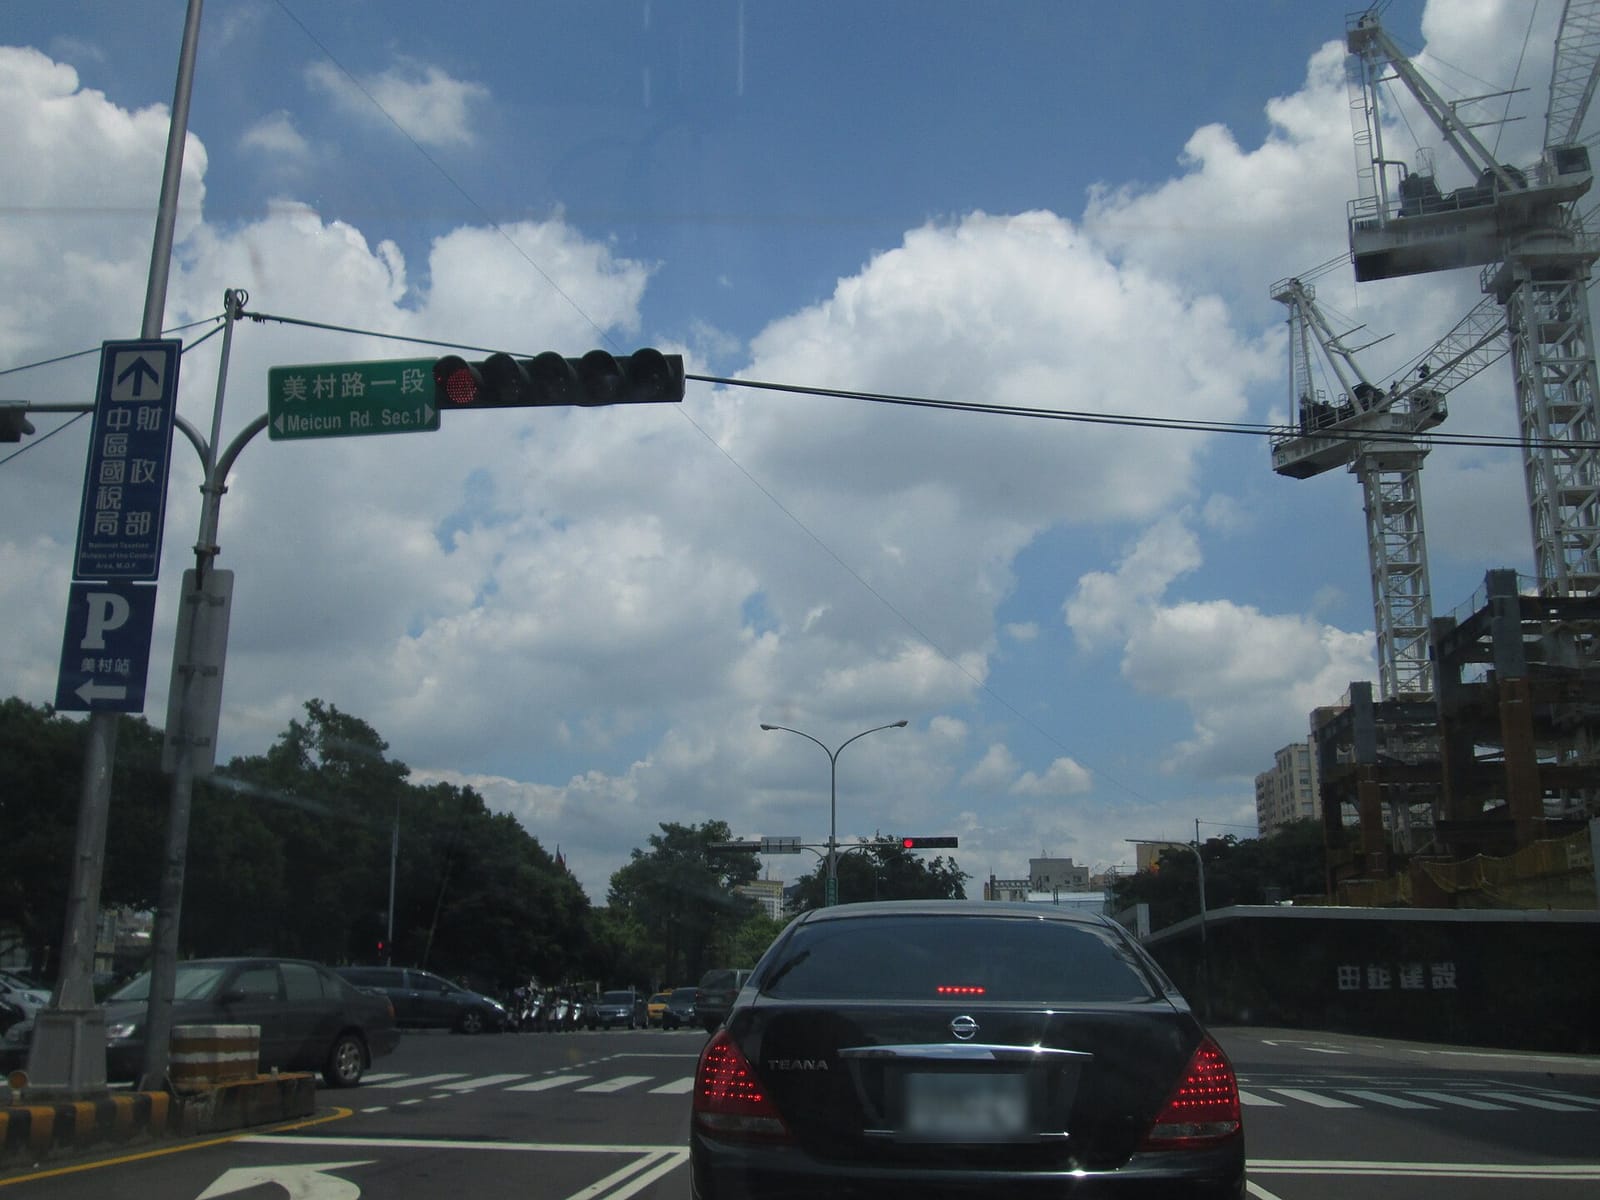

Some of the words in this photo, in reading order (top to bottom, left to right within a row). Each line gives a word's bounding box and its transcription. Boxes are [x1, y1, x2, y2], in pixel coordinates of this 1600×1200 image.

[282, 368, 425, 402] 美村路一段
[287, 414, 342, 432] Meicun
[350, 411, 373, 428] Rd.
[382, 407, 421, 426] Sec.1
[80, 592, 130, 649] P
[767, 1059, 829, 1071] TEANA
